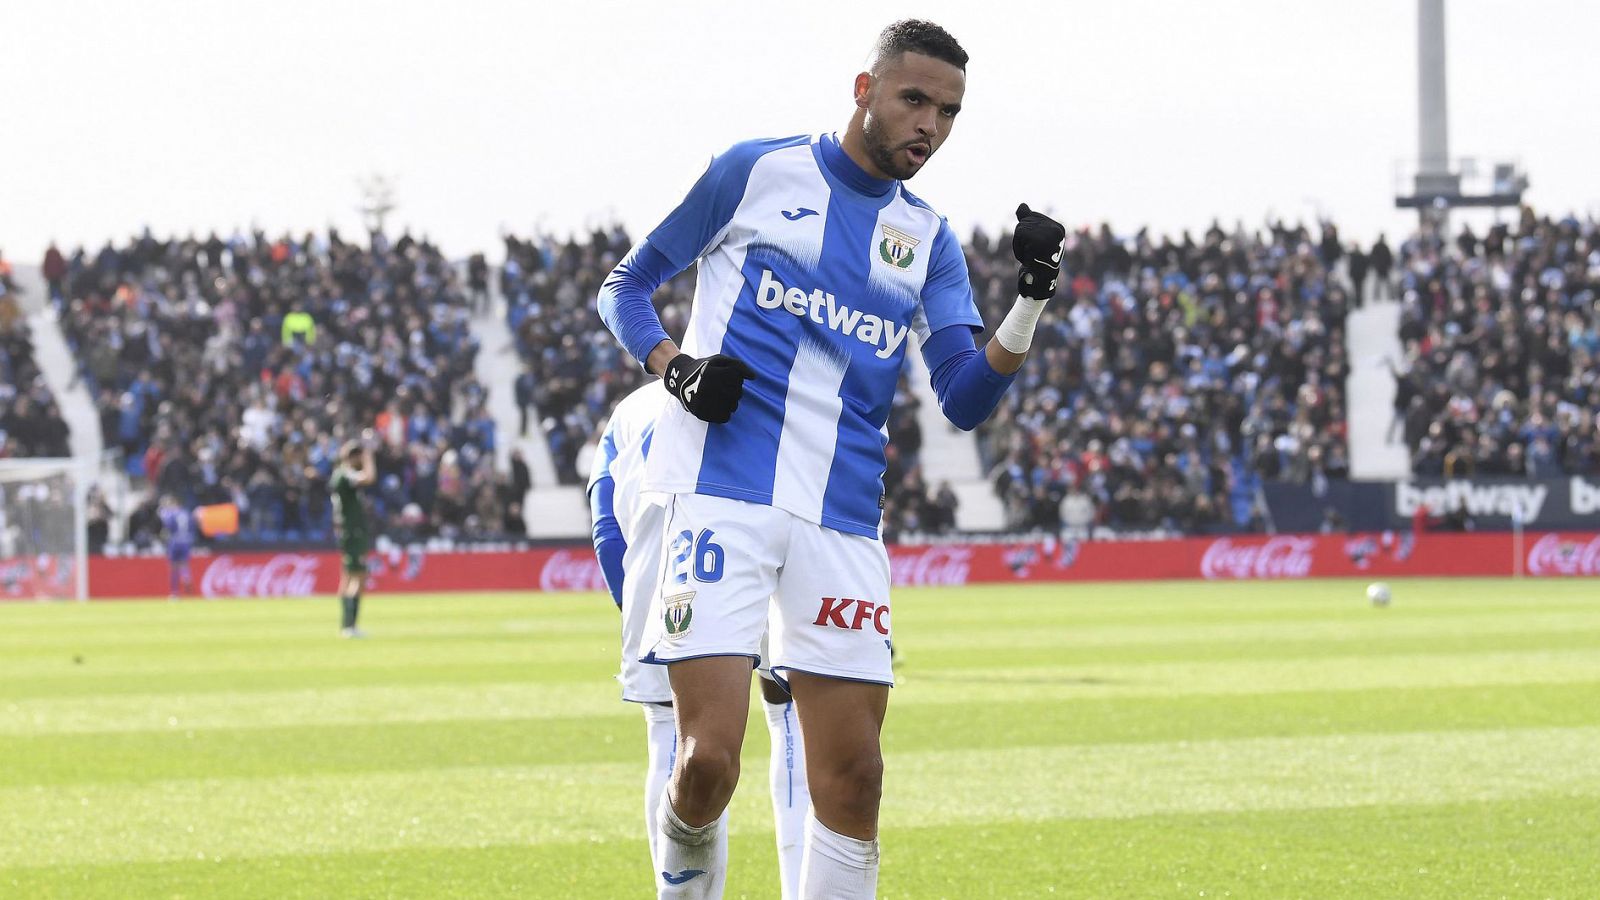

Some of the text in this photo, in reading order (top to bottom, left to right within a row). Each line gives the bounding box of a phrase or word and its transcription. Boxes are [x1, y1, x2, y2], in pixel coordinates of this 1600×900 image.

[756, 270, 908, 359] betway
[669, 367, 680, 388] 26
[1395, 480, 1546, 524] betway
[201, 554, 319, 598] Coca-Cola
[671, 528, 725, 584] 26
[1201, 537, 1314, 578] Coca-Cola
[812, 597, 890, 635] KFC
